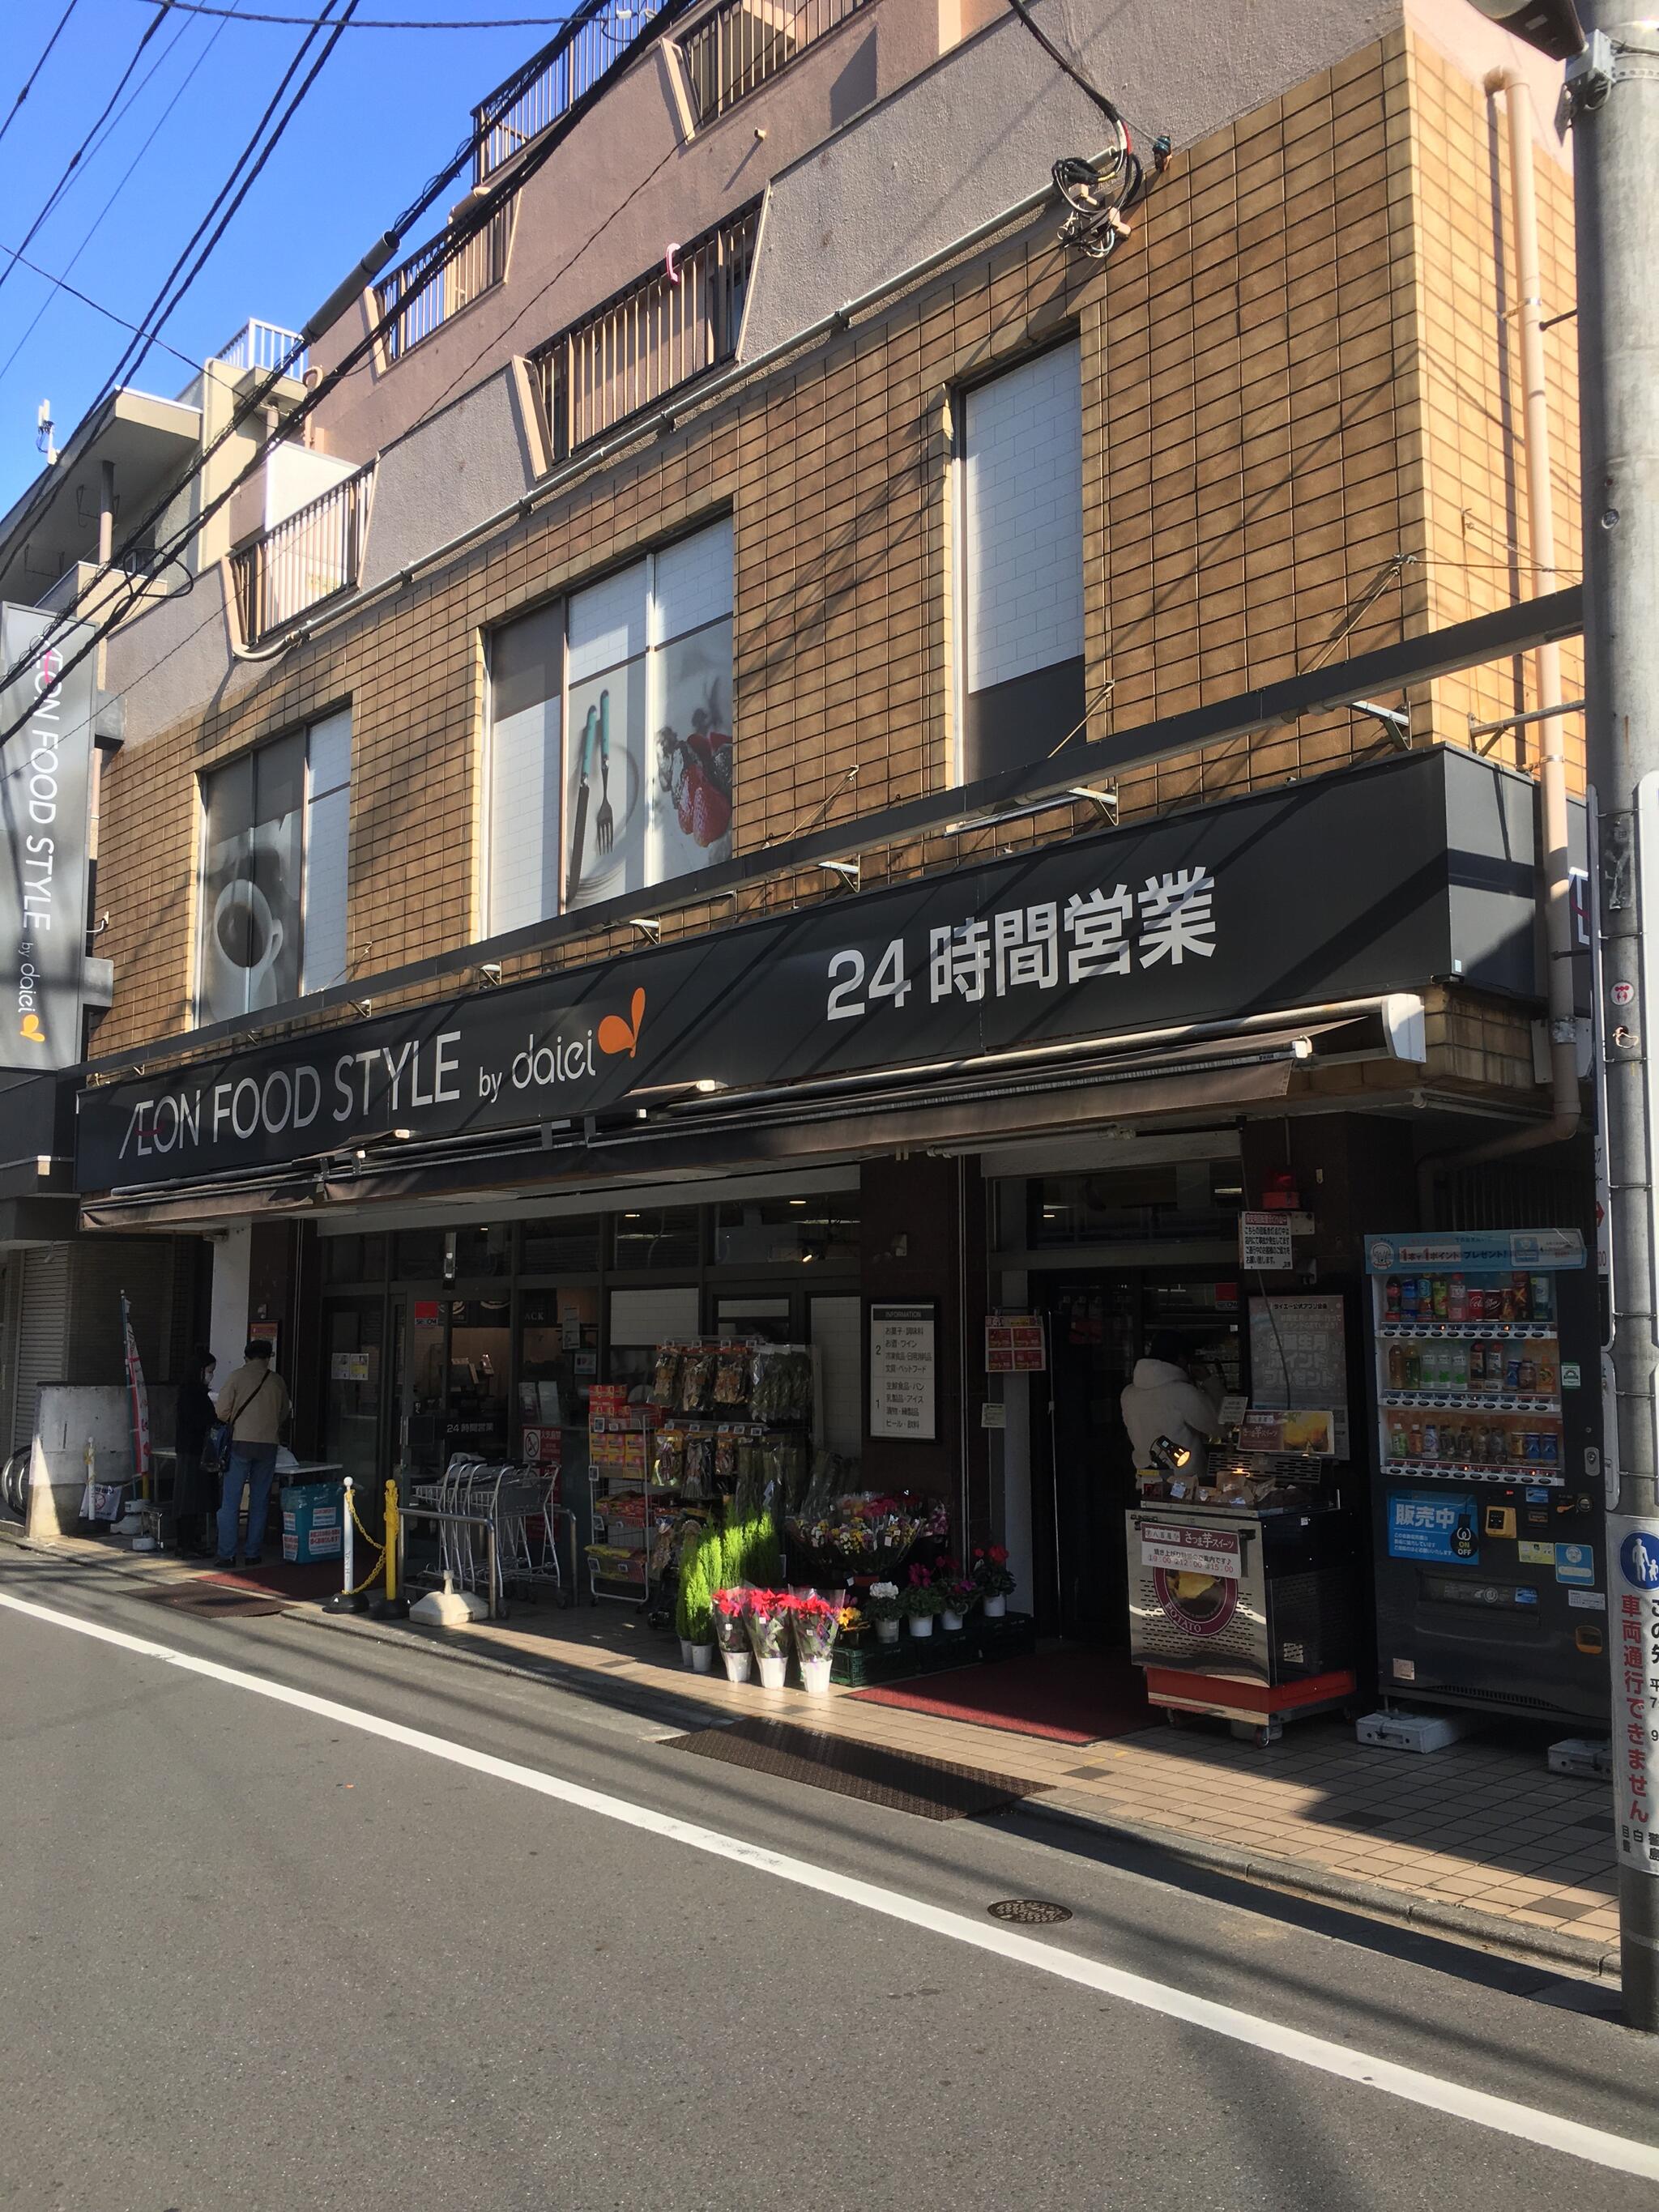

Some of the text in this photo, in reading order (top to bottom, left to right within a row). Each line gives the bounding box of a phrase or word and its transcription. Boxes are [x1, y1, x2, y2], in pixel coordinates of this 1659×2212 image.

[29, 730, 59, 824] FOOD
[23, 836, 55, 930] STYLE
[19, 942, 34, 955] by
[213, 1064, 321, 1144] FOOD
[333, 1031, 461, 1123] STYLE
[480, 1066, 503, 1104] by
[511, 1031, 596, 1089] daiei
[876, 1345, 881, 1356] 2
[876, 1400, 881, 1409] 1
[1395, 1503, 1455, 1529] 販売中
[1165, 1601, 1202, 1633] POTATO
[1621, 1593, 1649, 1822] 車両通行できません
